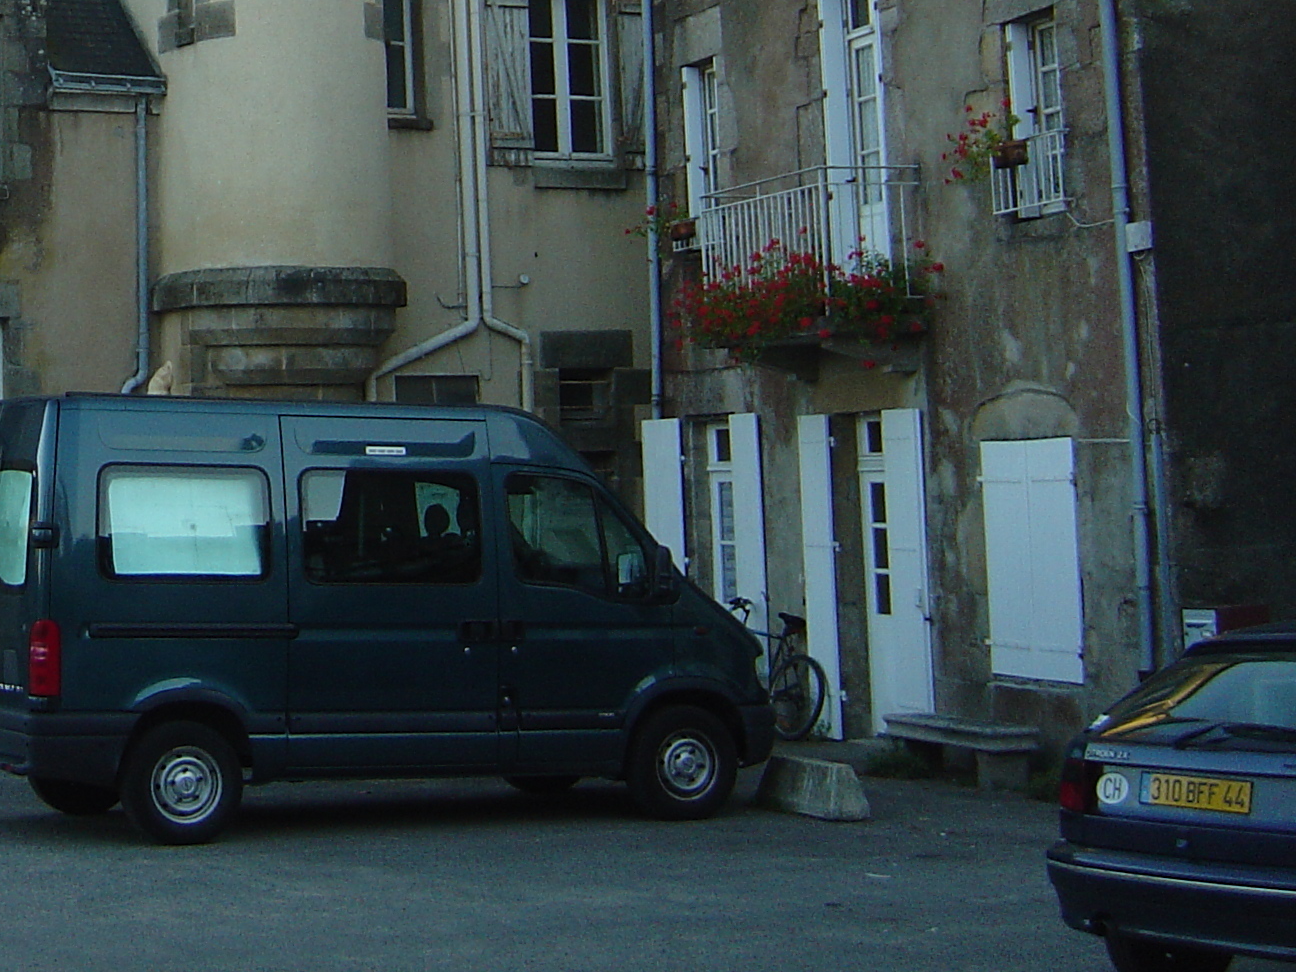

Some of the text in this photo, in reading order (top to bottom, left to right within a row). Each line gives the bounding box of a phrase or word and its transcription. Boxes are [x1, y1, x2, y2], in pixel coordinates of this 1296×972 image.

[1104, 777, 1122, 800] CH
[1151, 777, 1245, 808] 310 BFF 44
